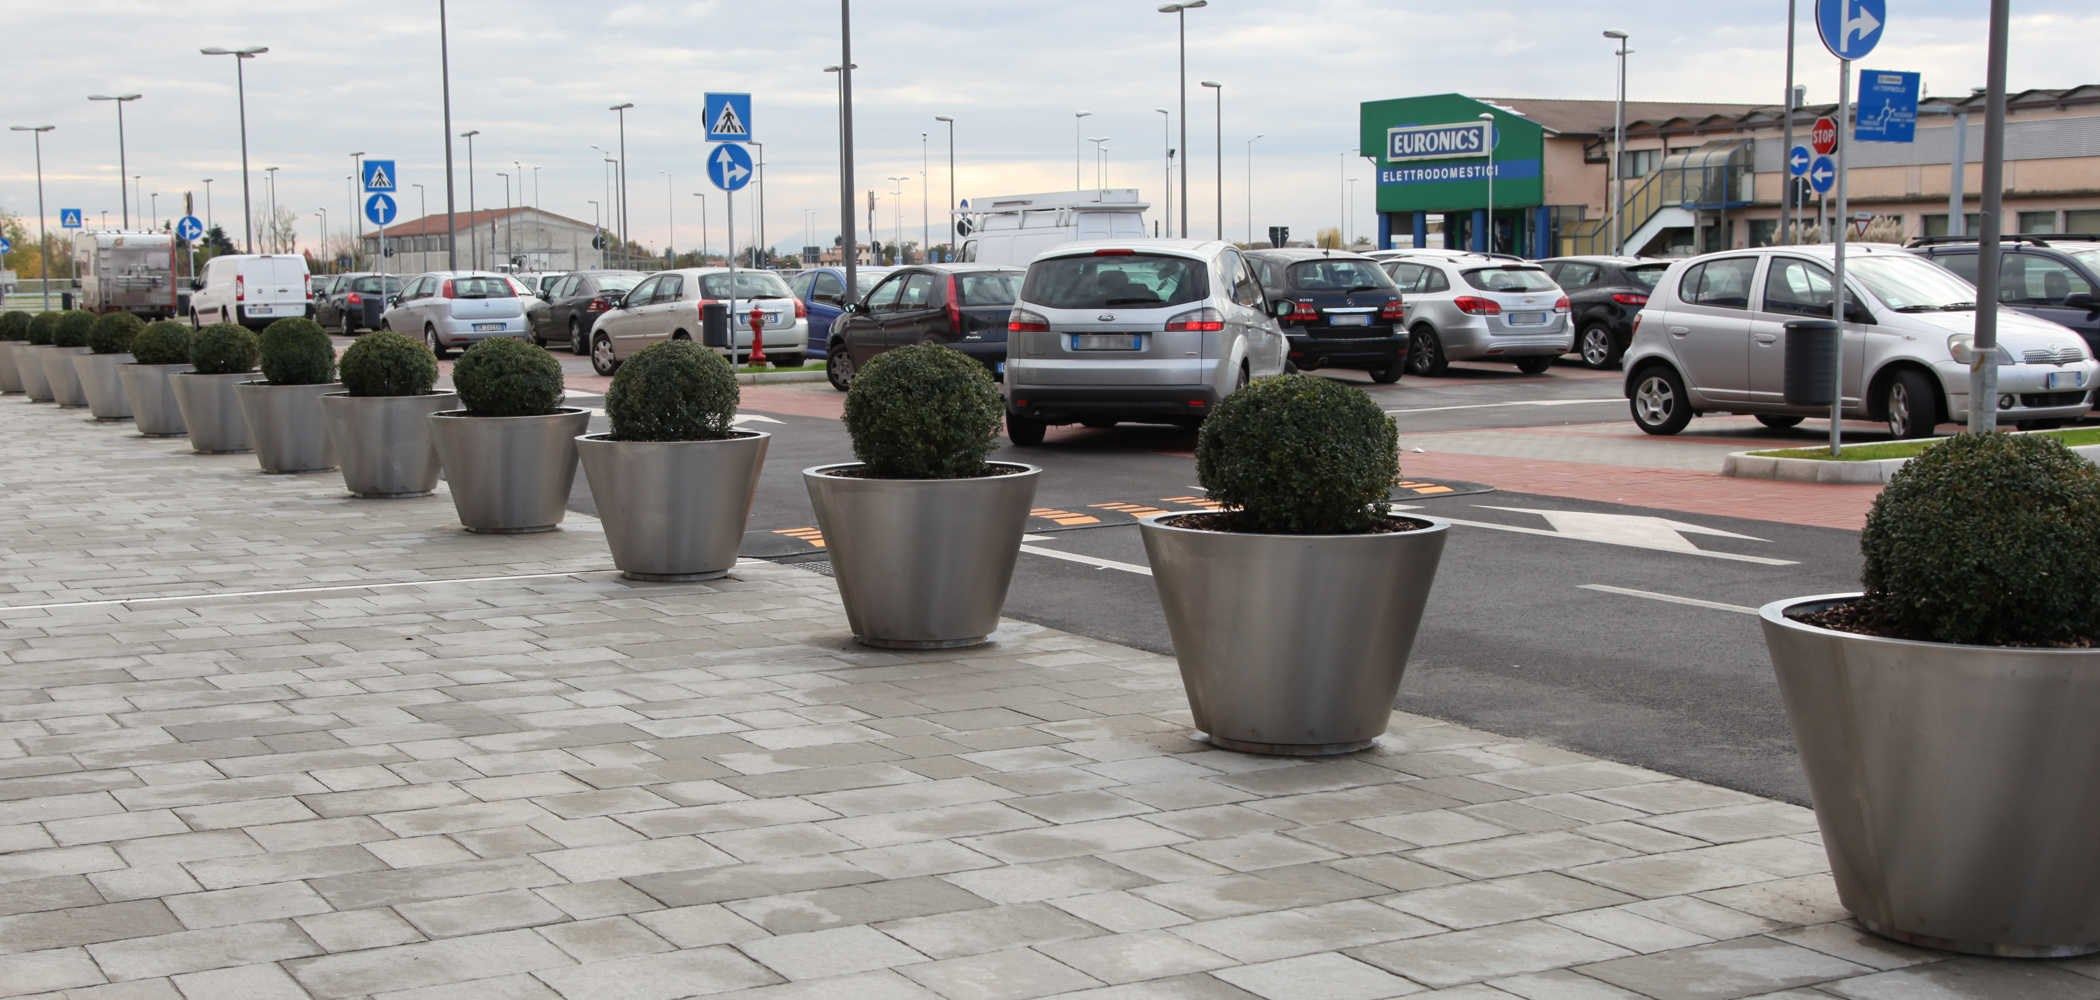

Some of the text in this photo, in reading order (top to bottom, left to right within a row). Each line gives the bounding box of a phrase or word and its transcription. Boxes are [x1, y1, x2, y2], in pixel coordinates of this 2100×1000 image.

[1394, 129, 1480, 154] EURONICS
[1812, 129, 1834, 144] STOP
[1383, 165, 1499, 183] ELETTRODOMESTICI
